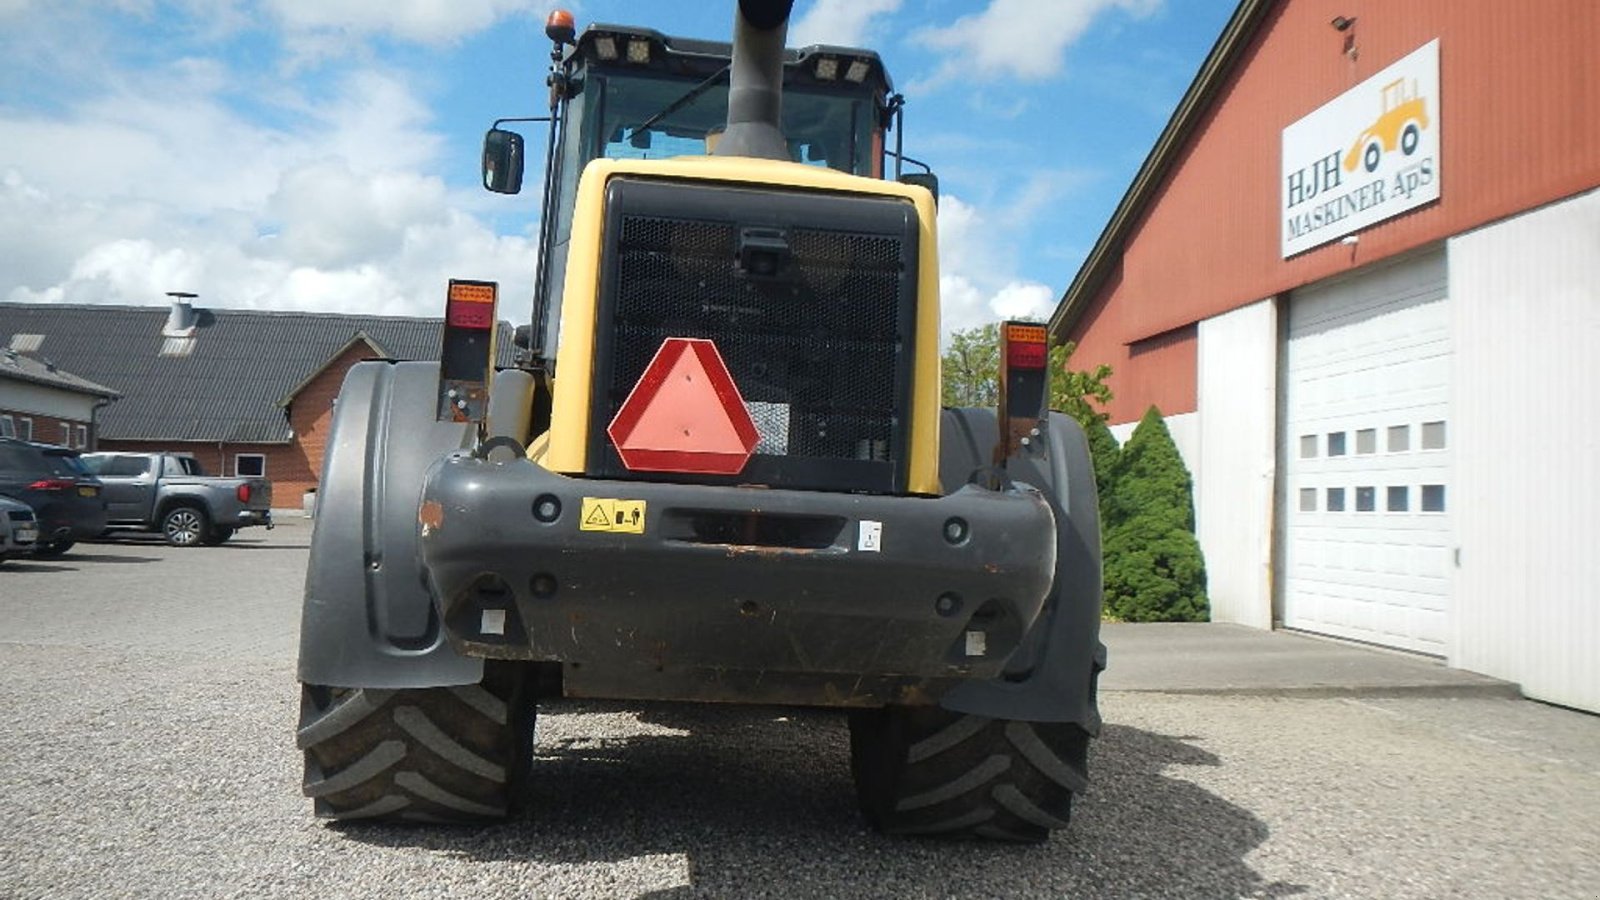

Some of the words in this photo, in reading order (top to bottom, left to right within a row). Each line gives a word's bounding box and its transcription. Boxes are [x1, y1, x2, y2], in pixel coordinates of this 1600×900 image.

[1288, 149, 1343, 208] HJH
[1288, 179, 1385, 240] MASKINER
[1392, 157, 1433, 200] ApS
